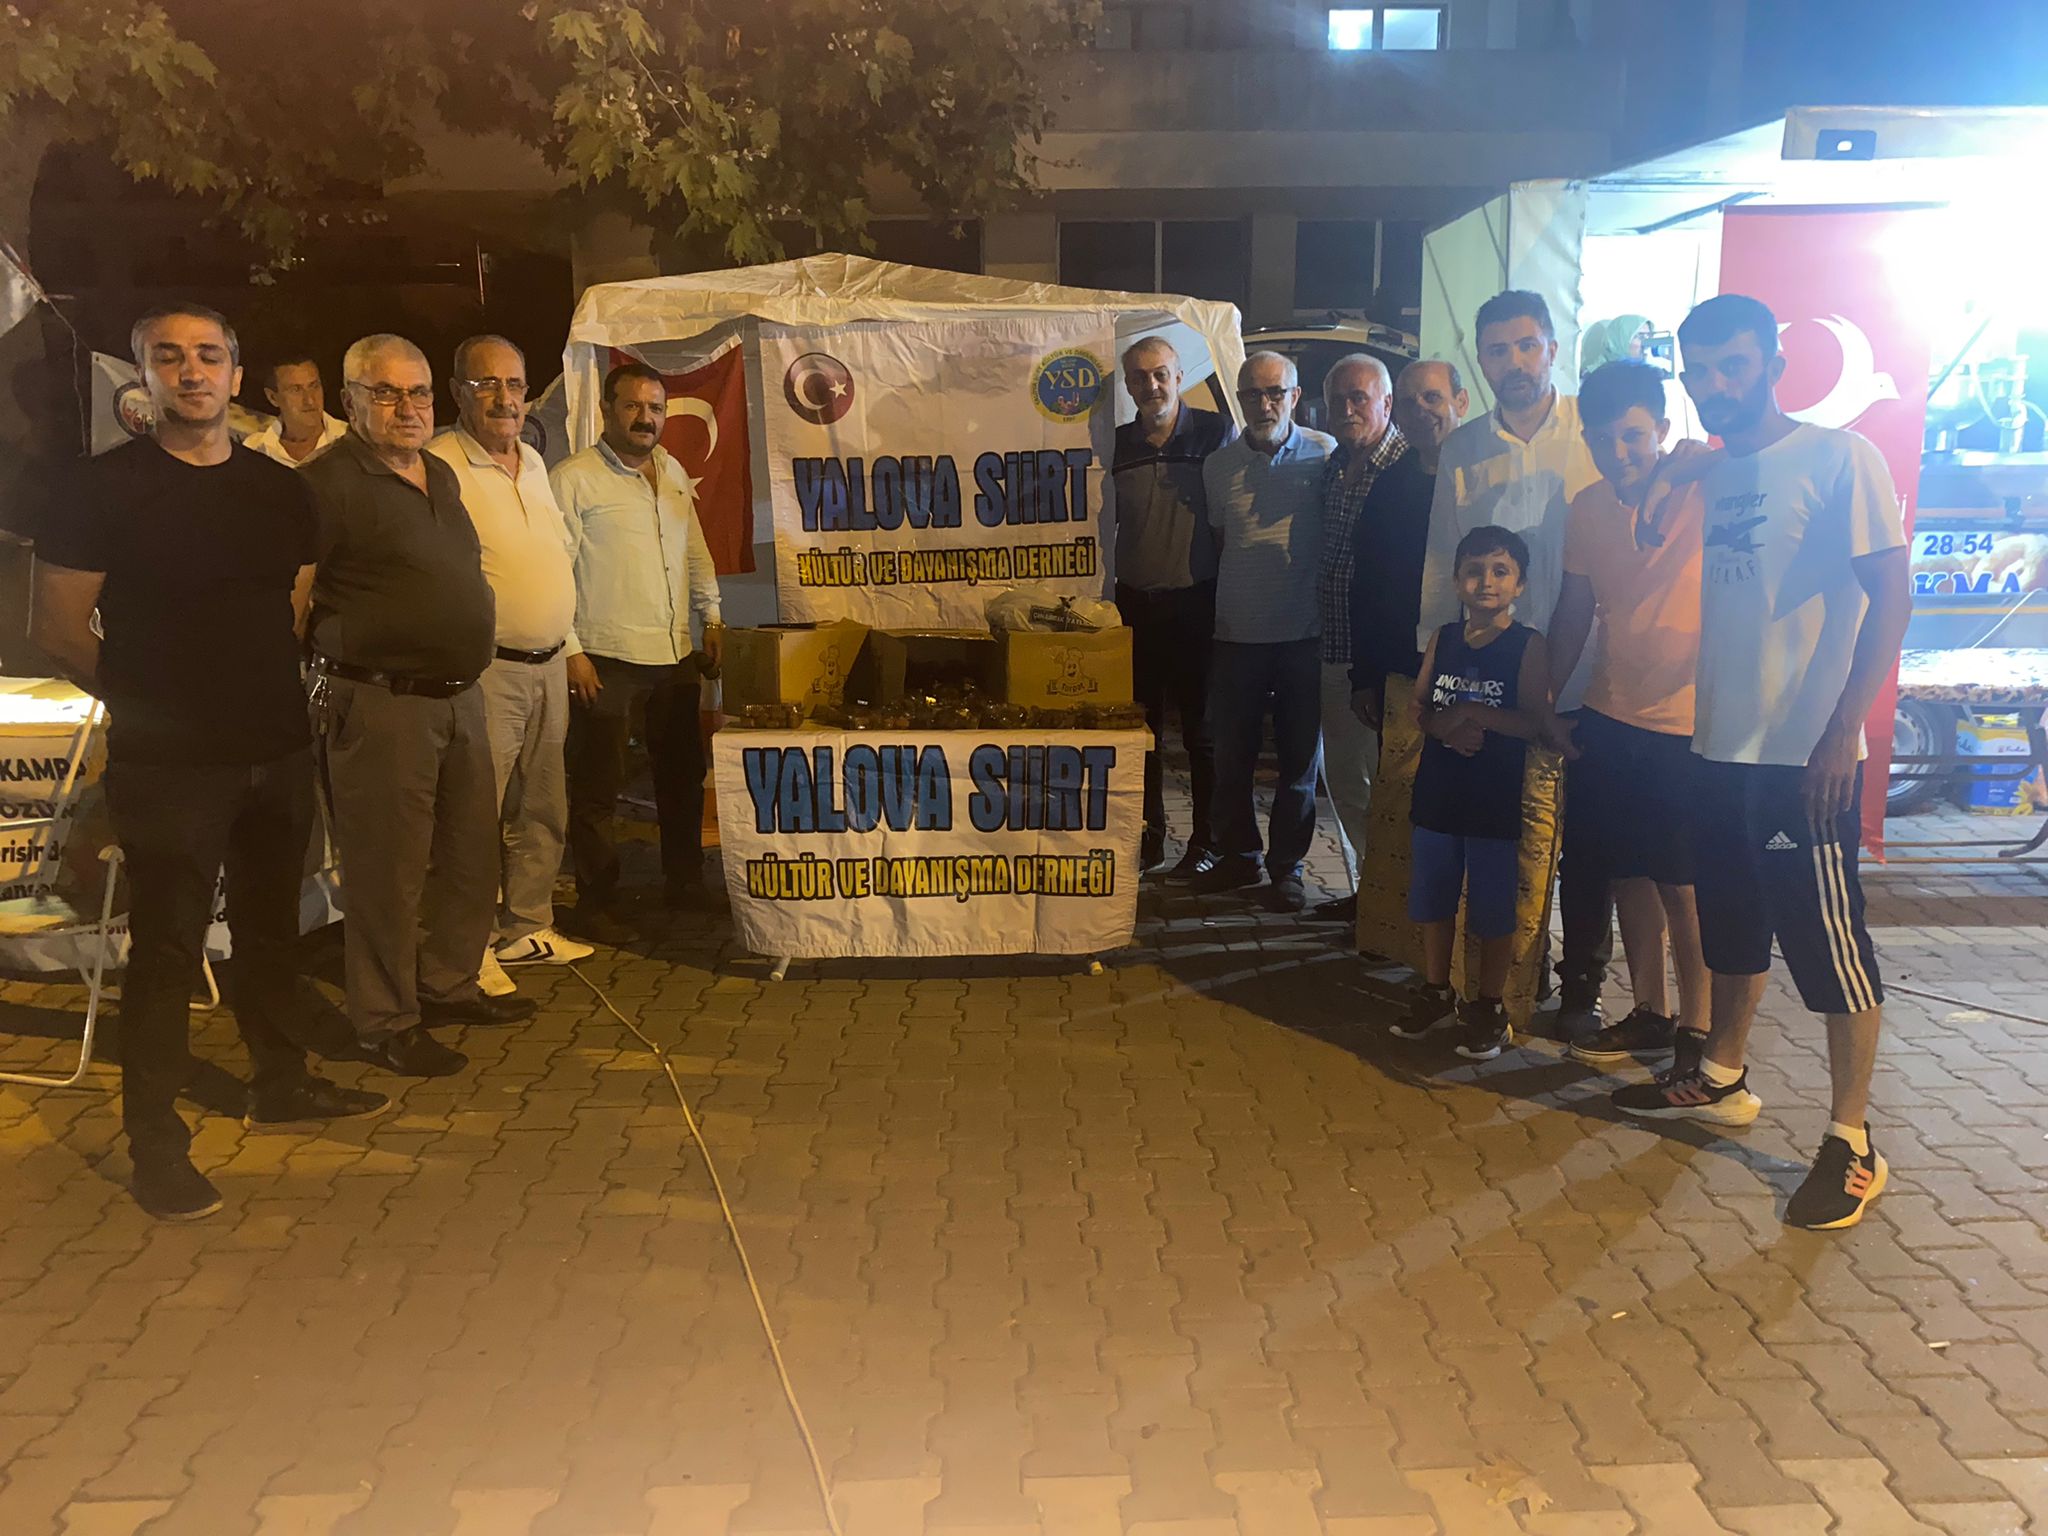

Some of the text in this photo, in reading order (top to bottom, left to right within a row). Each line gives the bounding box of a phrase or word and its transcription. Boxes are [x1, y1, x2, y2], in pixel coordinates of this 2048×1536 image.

[1044, 367, 1096, 391] YSD
[793, 454, 962, 532] YALOVA
[797, 536, 1096, 586] KÜLTÜR VE DAYANIŞMA DERNEĞİ
[1923, 533, 1994, 556] 28 54
[742, 744, 953, 834] YALOVA
[1765, 842, 1798, 850] adidas
[746, 849, 1115, 903] KÜLTÜR VE DAYANIŞMA DERNEĞİ
